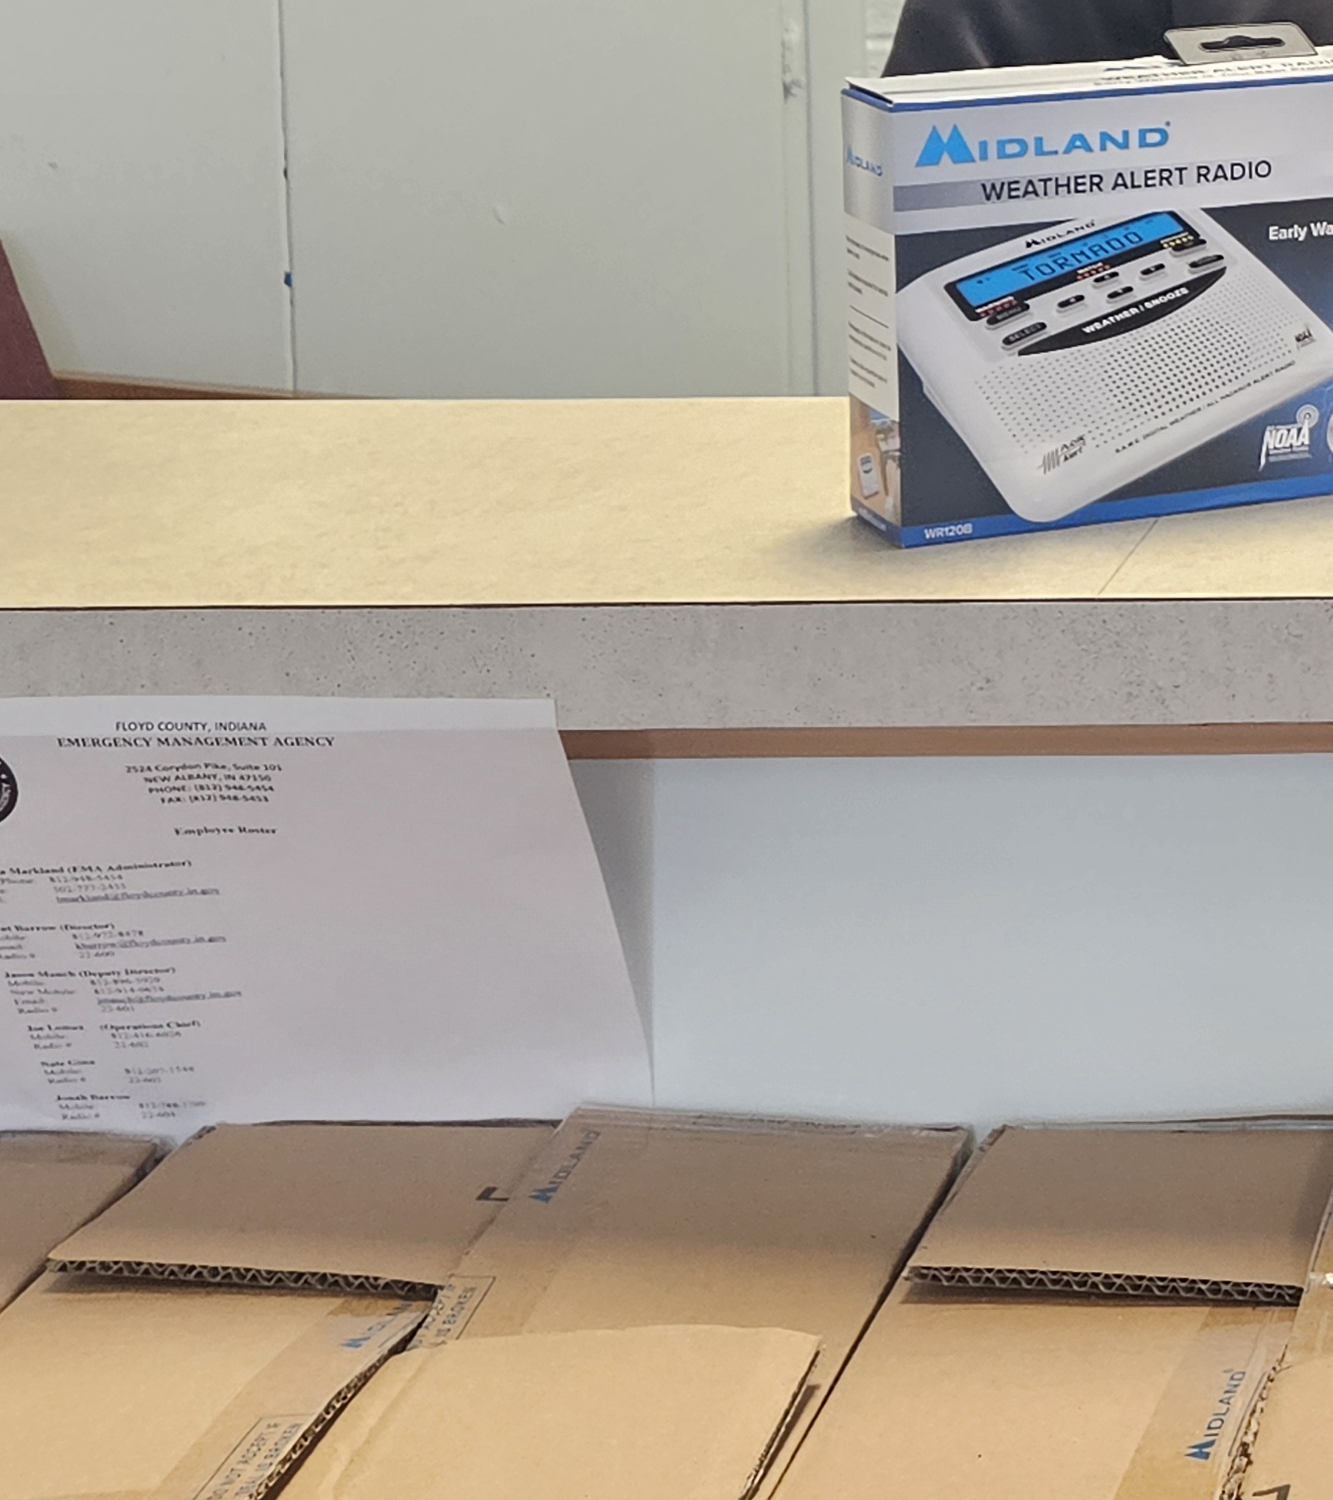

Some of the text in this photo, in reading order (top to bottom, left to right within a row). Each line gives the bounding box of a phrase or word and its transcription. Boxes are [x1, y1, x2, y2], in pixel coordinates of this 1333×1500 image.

[914, 123, 1170, 168] MIDLAND
[981, 159, 1272, 203] WEATHER ALERT RADIO
[1025, 221, 1094, 248] MIDLAND
[1268, 224, 1307, 241] Early
[1021, 231, 1144, 280] TORNADO
[1081, 305, 1139, 334] WEATHER
[1145, 287, 1190, 310] SNOOZE
[1260, 424, 1309, 458] NOAA
[924, 523, 973, 540] WR120B
[57, 736, 335, 749] EMERGENCY MANAGEMENT AGENCY
[116, 721, 267, 733] FLOYD COUNTY, INDIANA
[528, 1128, 600, 1204] MIDLAND
[1184, 1370, 1246, 1461] MIDLAND
